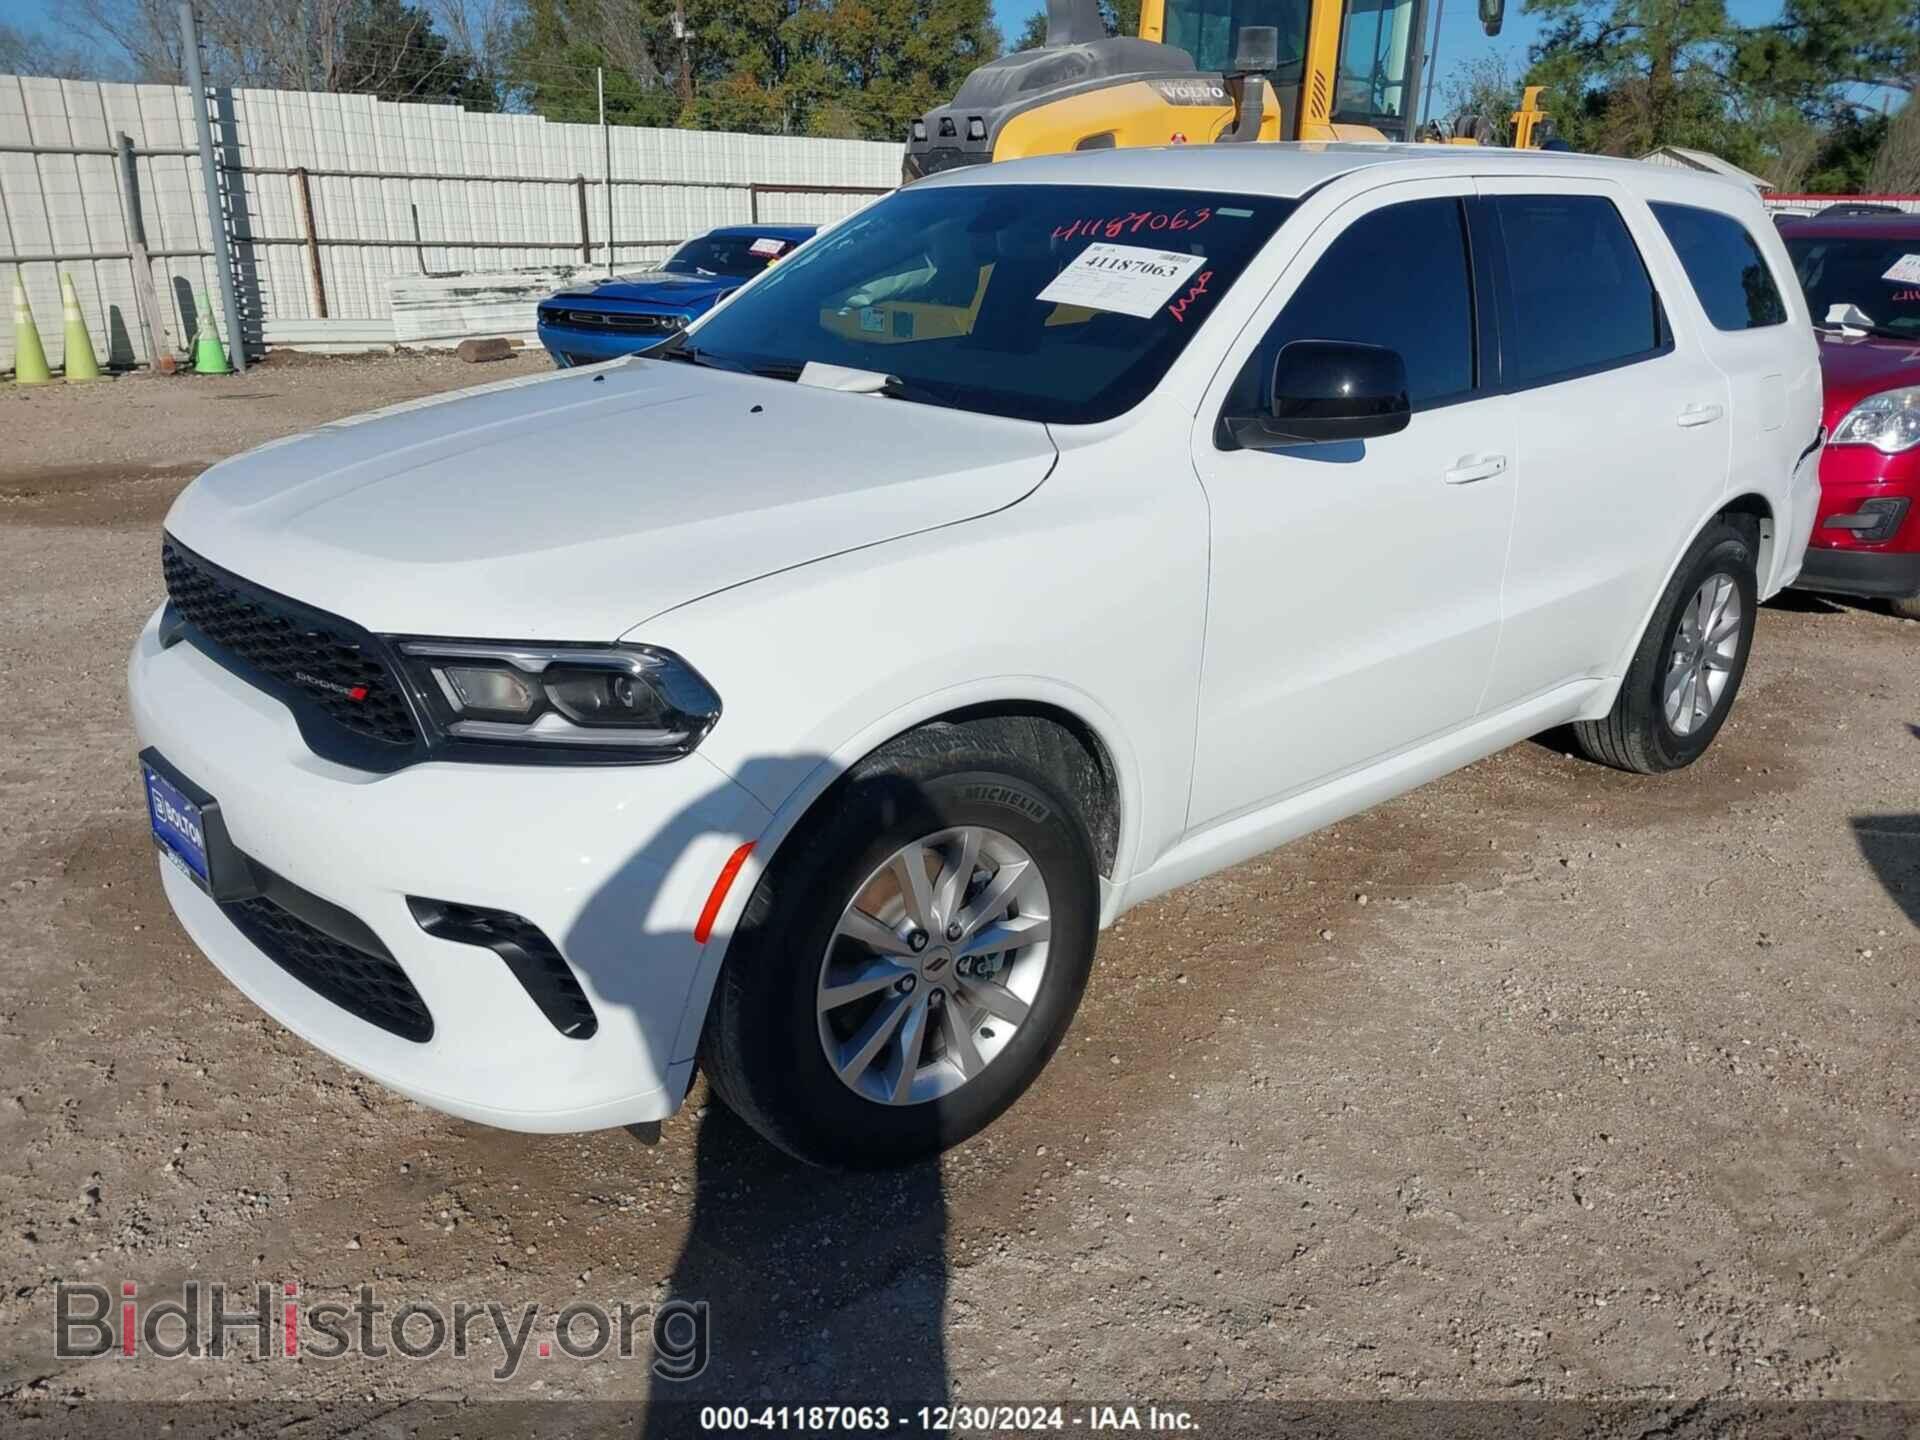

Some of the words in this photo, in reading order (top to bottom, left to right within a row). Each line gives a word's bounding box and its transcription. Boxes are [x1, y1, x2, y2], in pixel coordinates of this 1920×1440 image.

[1160, 87, 1224, 98] VOLVO
[1085, 256, 1179, 278] 41187063
[965, 786, 1048, 818] MICHELIN
